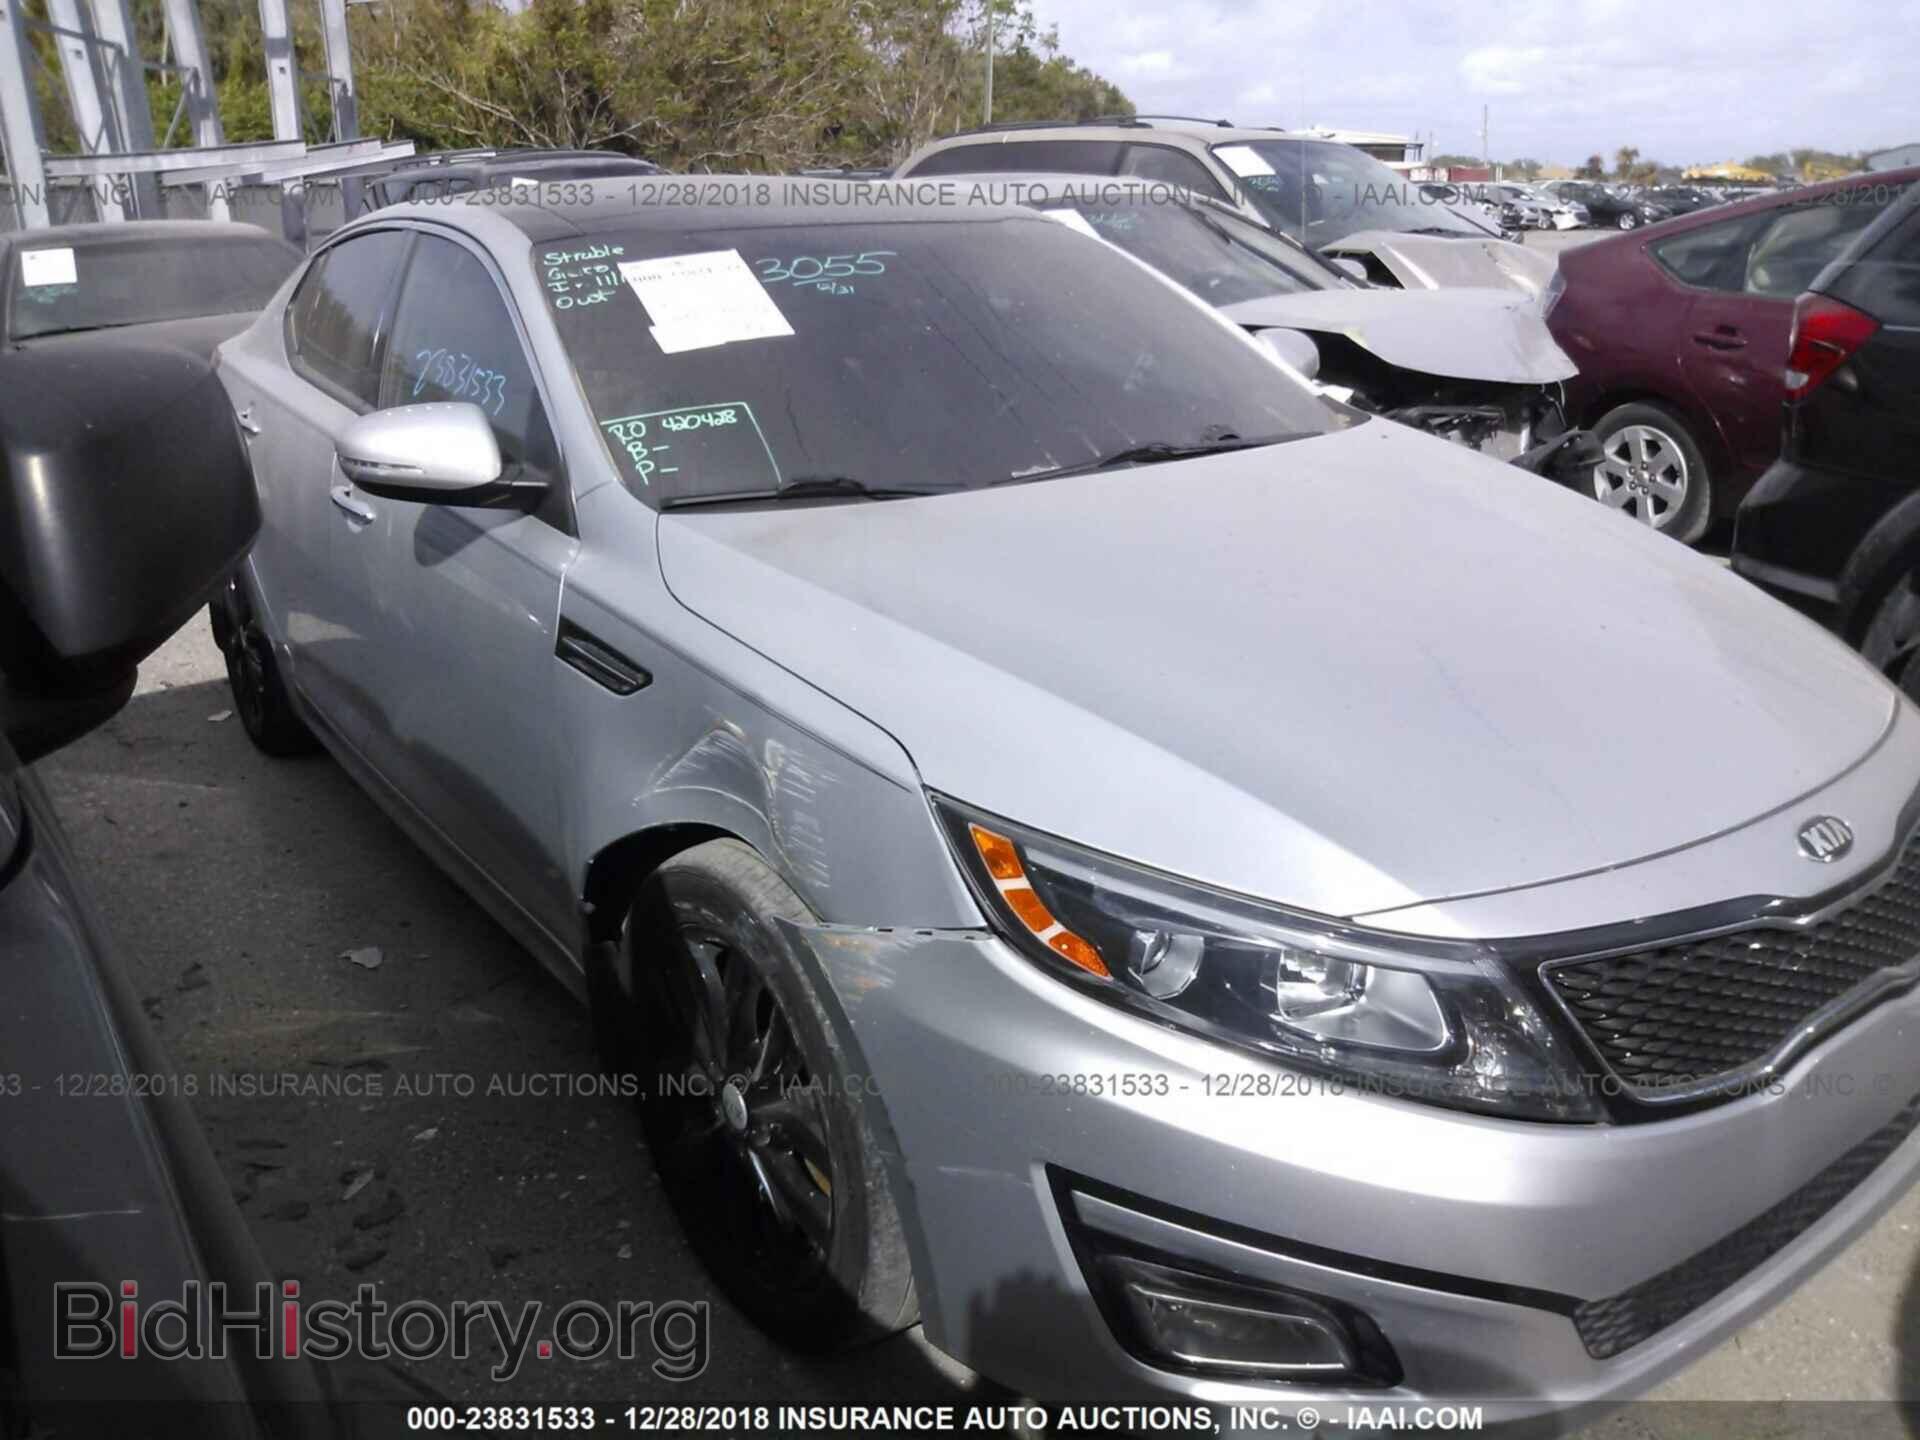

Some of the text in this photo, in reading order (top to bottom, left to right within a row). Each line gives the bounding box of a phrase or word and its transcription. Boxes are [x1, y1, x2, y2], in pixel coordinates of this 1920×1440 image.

[756, 251, 897, 283] 3055
[661, 409, 737, 432] 420428
[1800, 817, 1852, 857] KIA
